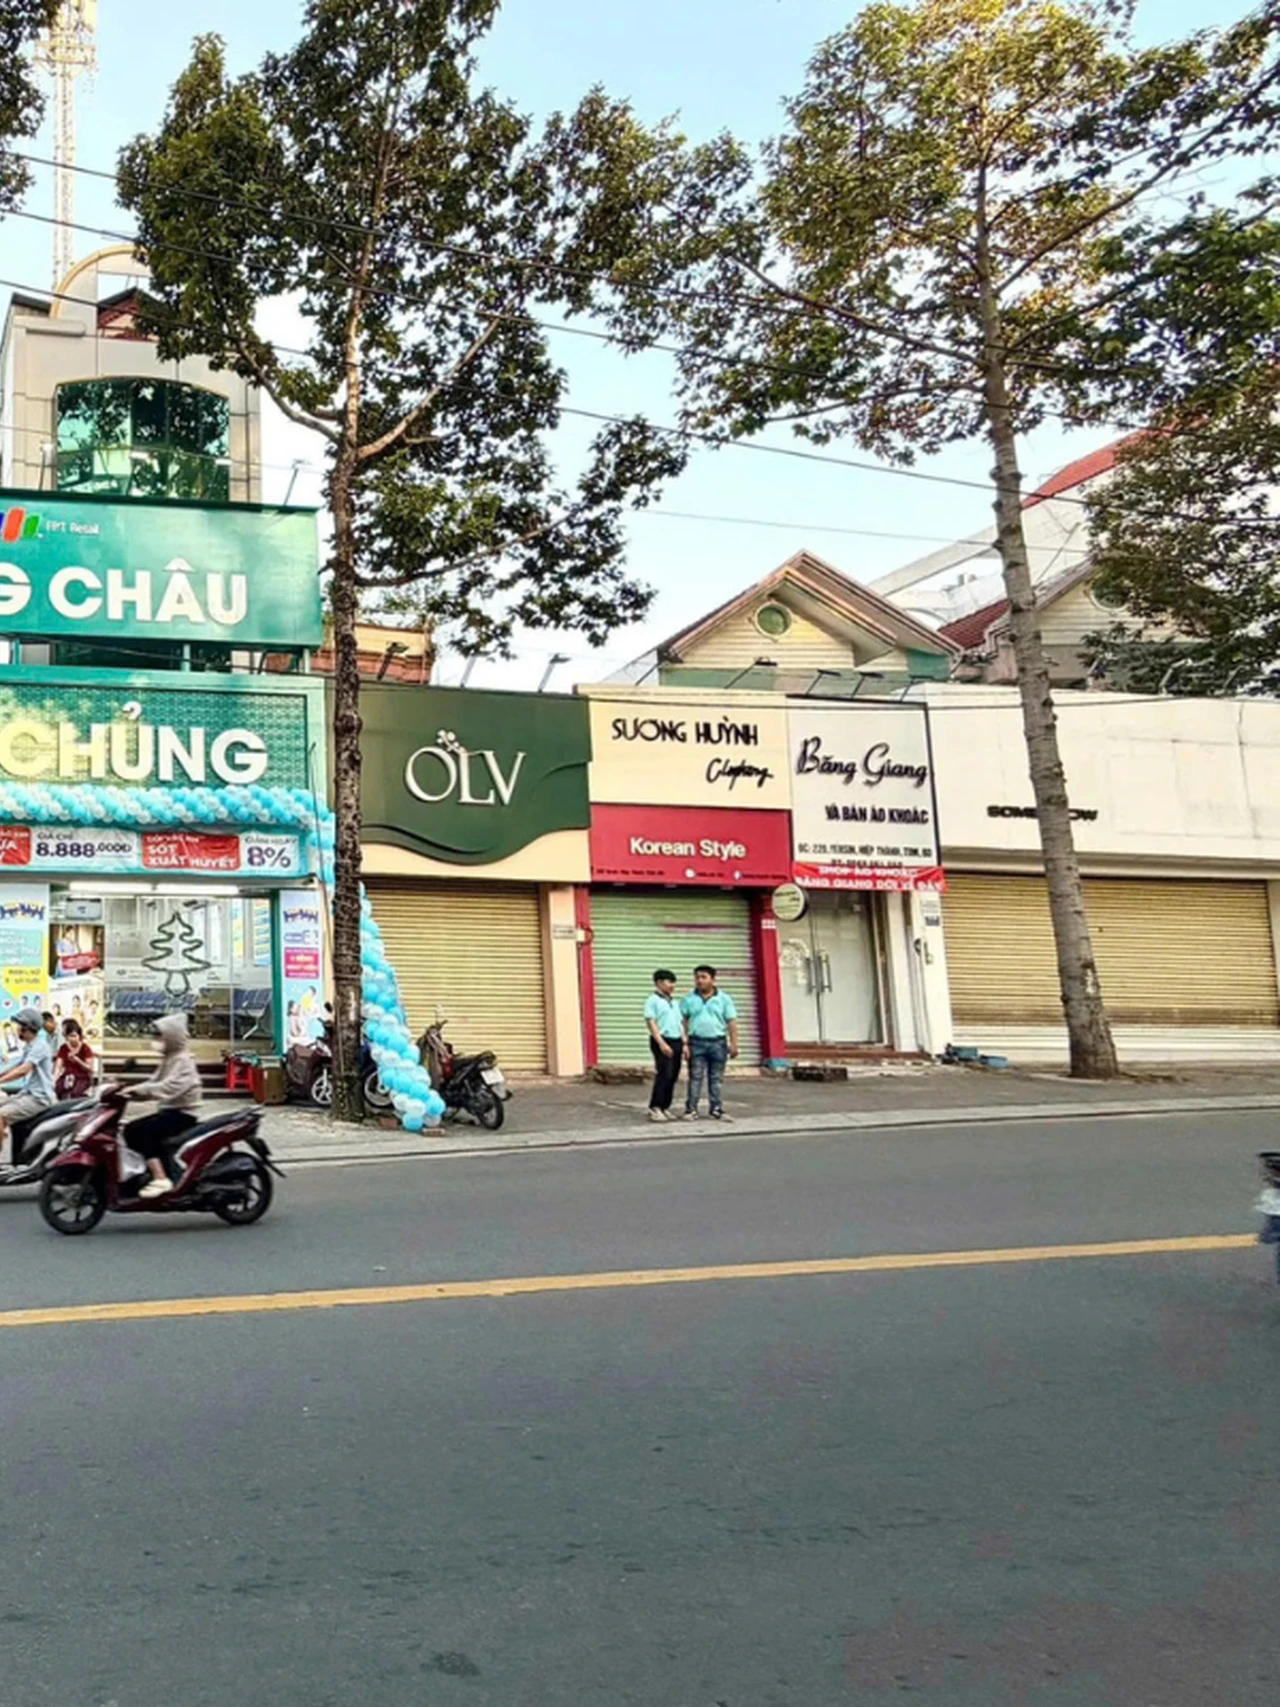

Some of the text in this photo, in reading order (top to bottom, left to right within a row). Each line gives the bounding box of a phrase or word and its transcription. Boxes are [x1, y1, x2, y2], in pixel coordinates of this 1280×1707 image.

[48, 557, 248, 625] CHÂU
[694, 715, 758, 746] HUỲNH
[796, 736, 927, 788] Băng Giang
[888, 808, 929, 825] KHOÁC
[247, 846, 291, 868] 8%
[630, 837, 746, 861] Korean Style
[190, 856, 235, 868] HUYẾT
[833, 879, 872, 889] GIANG
